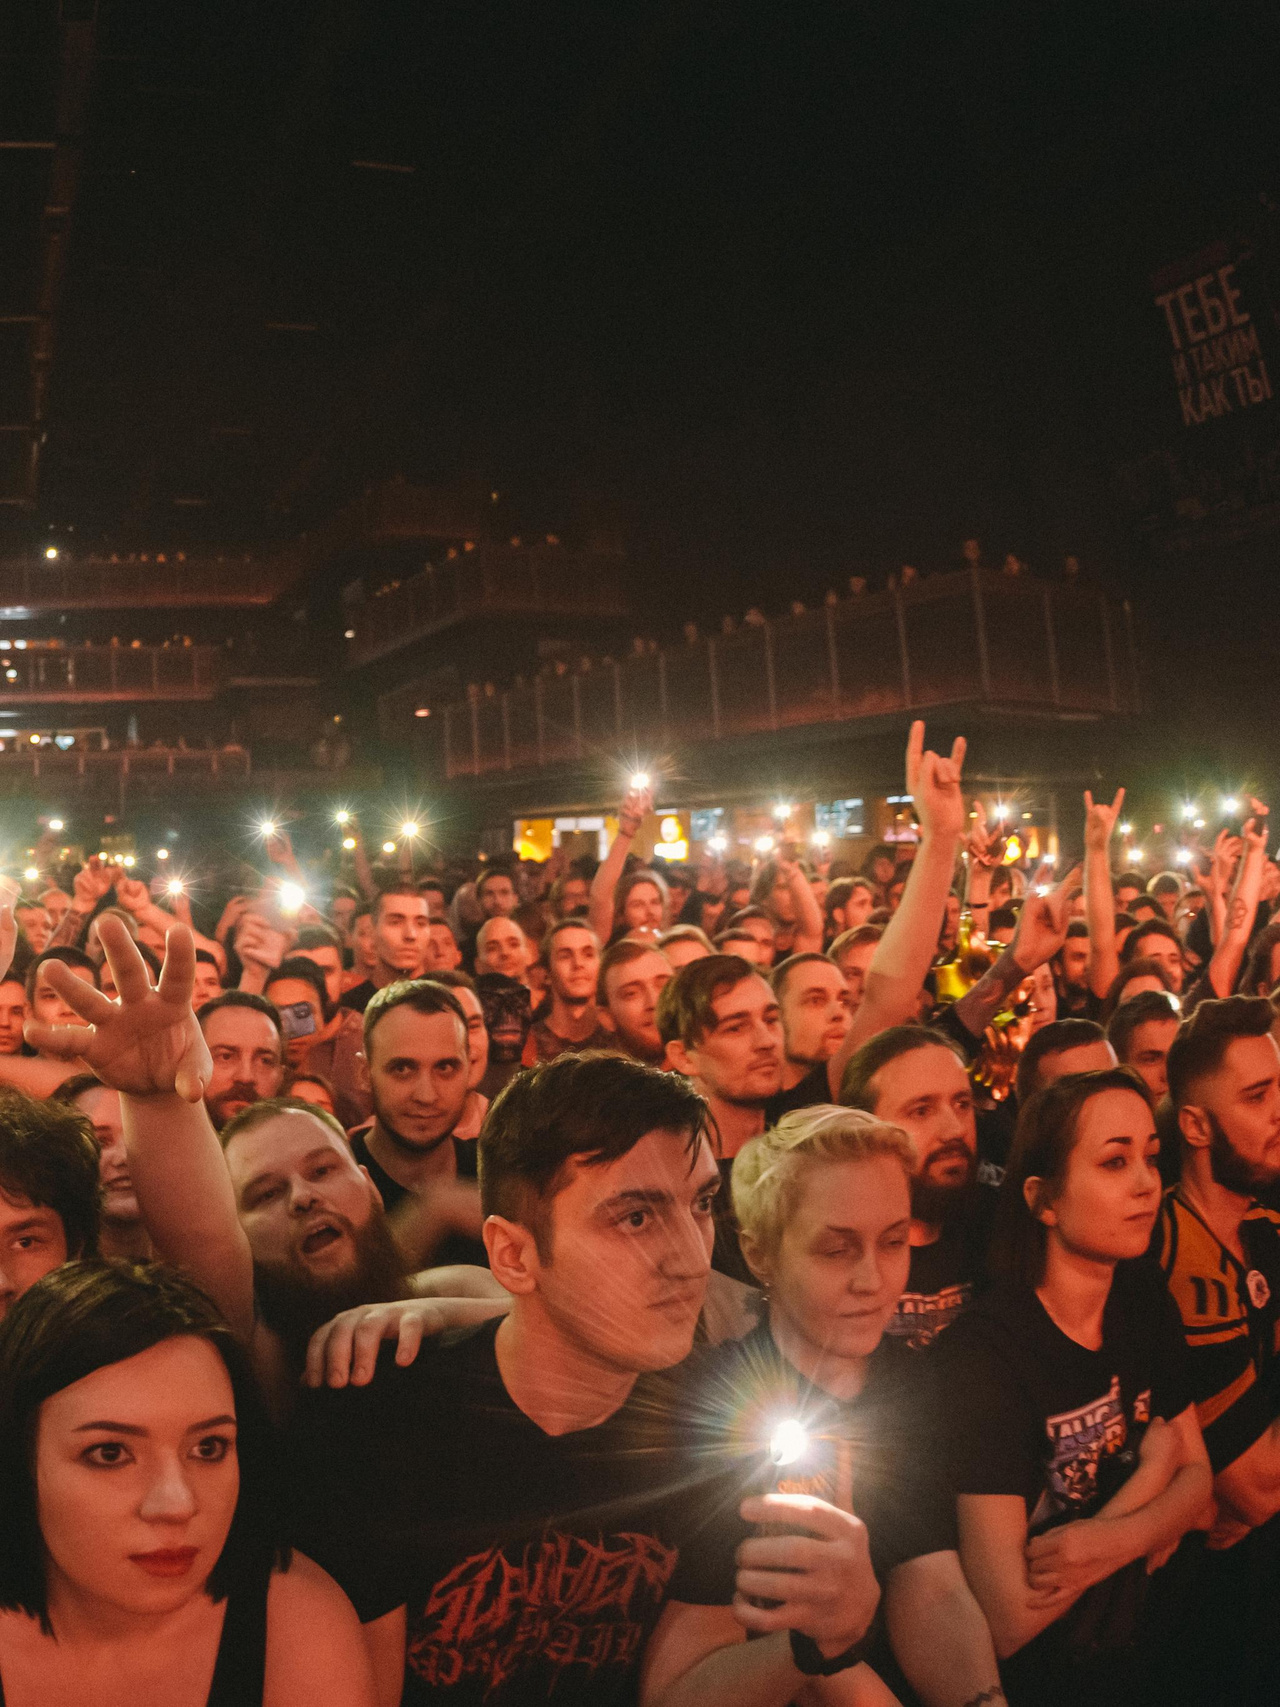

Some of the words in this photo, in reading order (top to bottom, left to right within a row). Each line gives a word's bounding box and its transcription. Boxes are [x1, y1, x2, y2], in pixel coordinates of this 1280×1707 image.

[1155, 264, 1250, 349] ТЕБЕ
[1189, 323, 1263, 379] ТАКИМ
[1178, 373, 1234, 427] КАК
[1229, 359, 1274, 409] ТЫ
[1189, 1275, 1228, 1317] 11
